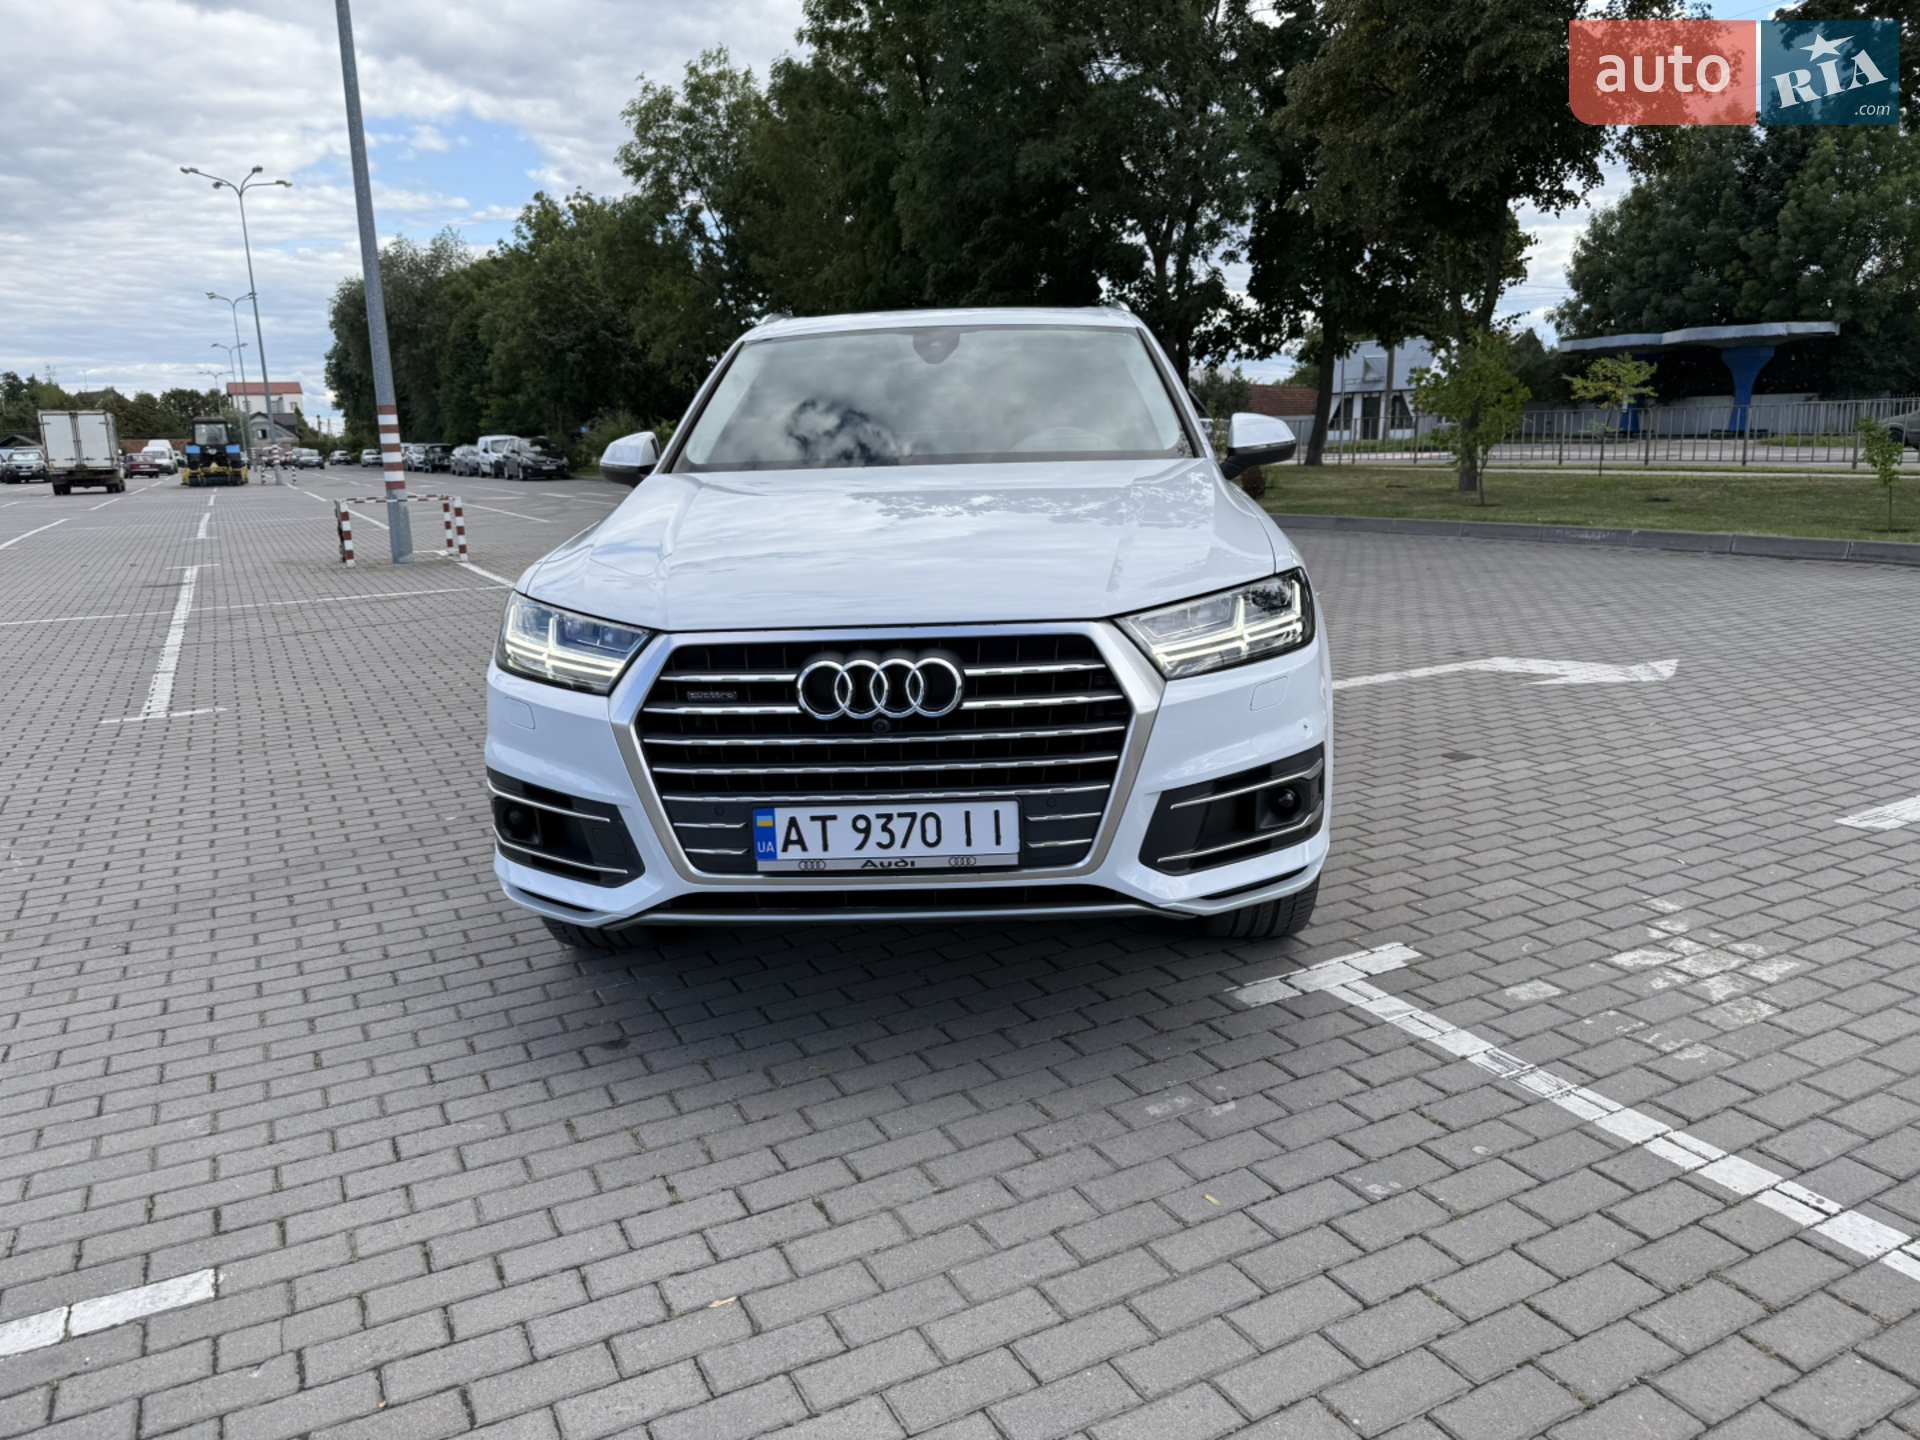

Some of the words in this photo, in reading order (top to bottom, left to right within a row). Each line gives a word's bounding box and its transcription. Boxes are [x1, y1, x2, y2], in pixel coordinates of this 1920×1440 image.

[781, 814, 838, 852] AT
[851, 811, 942, 851] 9370
[757, 841, 775, 853] UA
[860, 859, 916, 869] Audi
